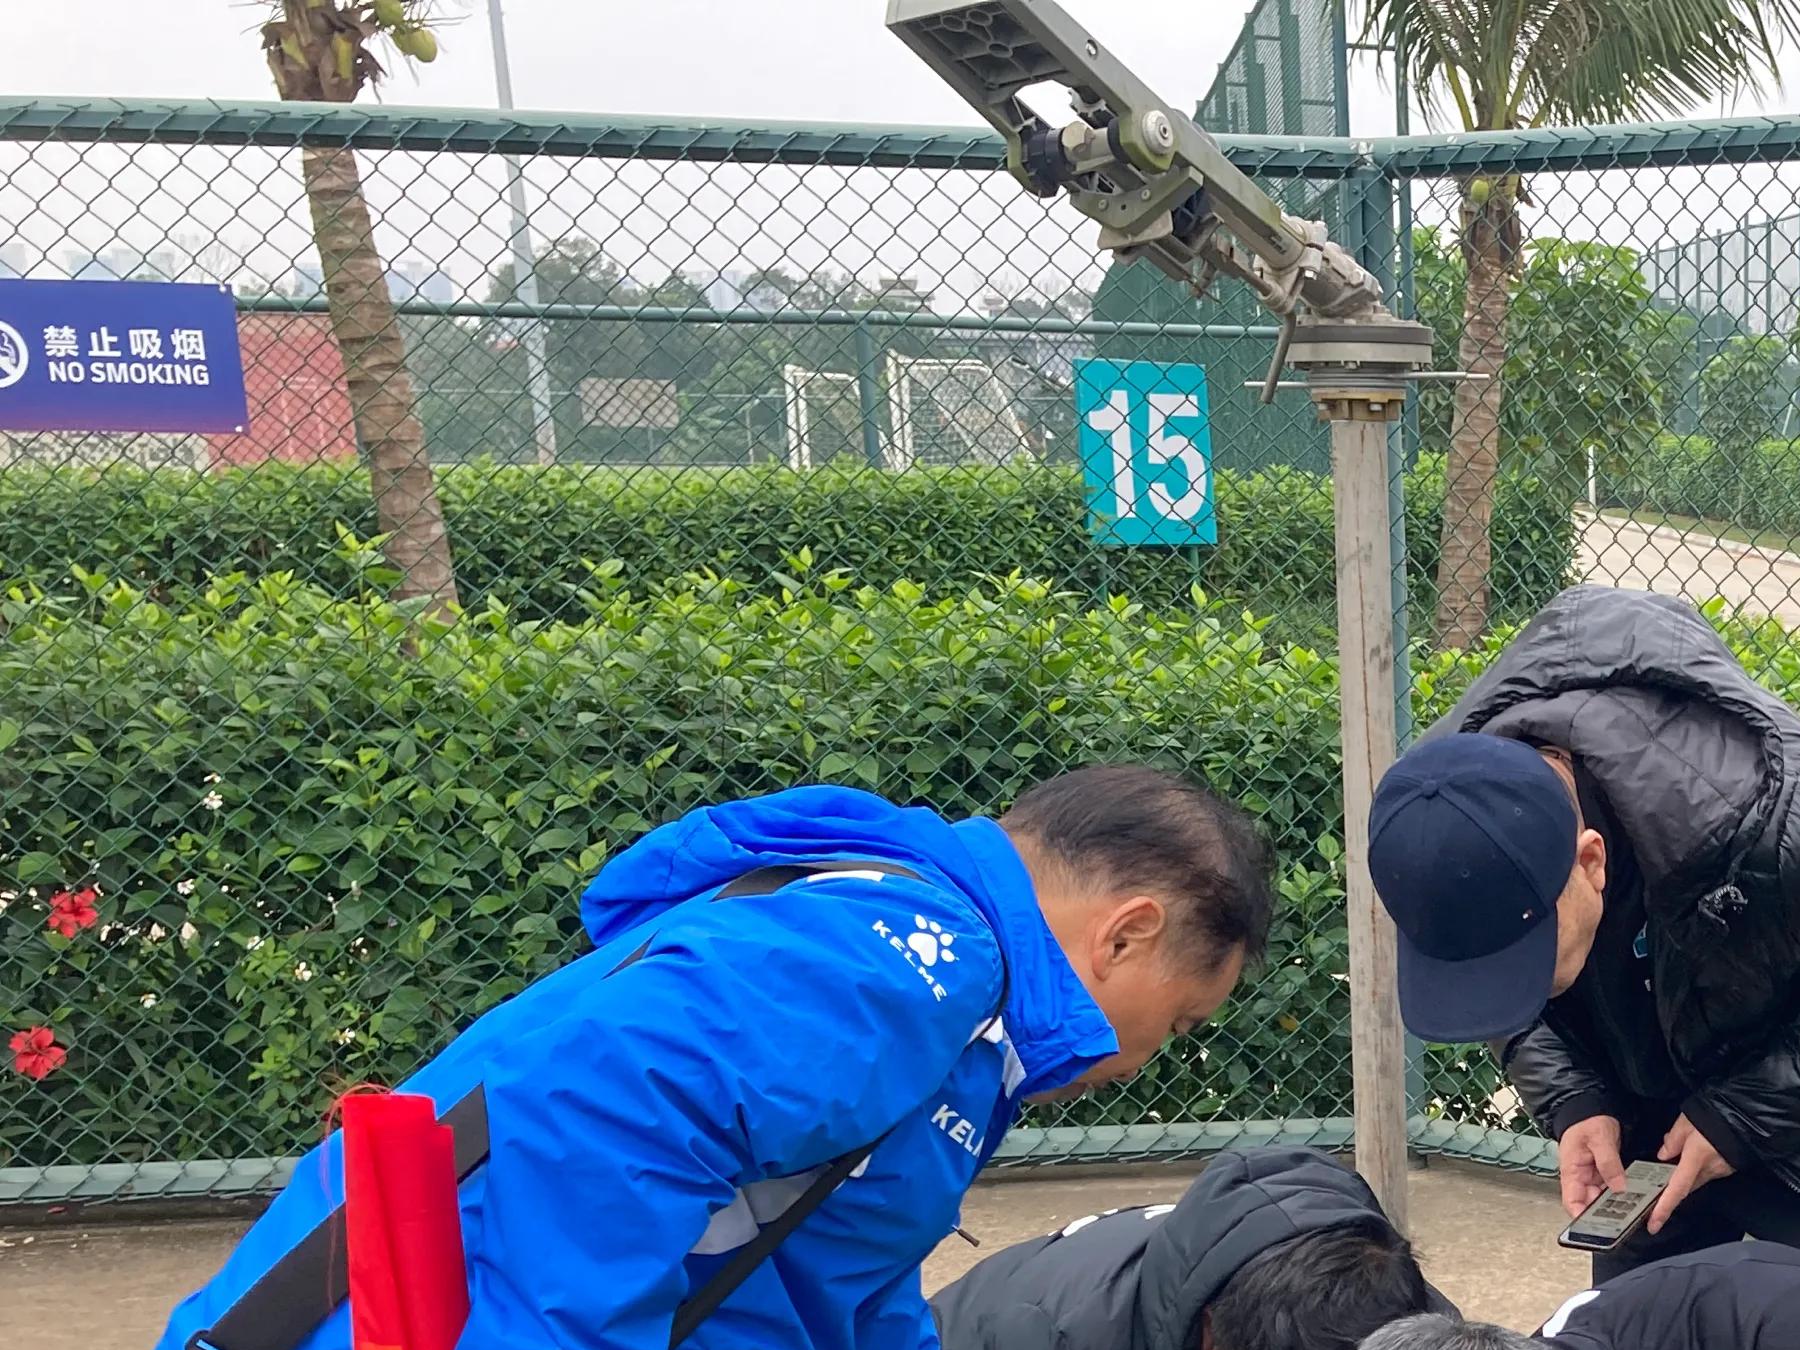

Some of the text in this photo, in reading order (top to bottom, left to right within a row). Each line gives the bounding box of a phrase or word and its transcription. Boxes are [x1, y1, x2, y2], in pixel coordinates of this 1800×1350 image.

[43, 325, 207, 361] 禁止吸烟
[48, 361, 209, 386] NO SMOKING
[1088, 389, 1207, 521] 15
[872, 919, 948, 1002] KELME
